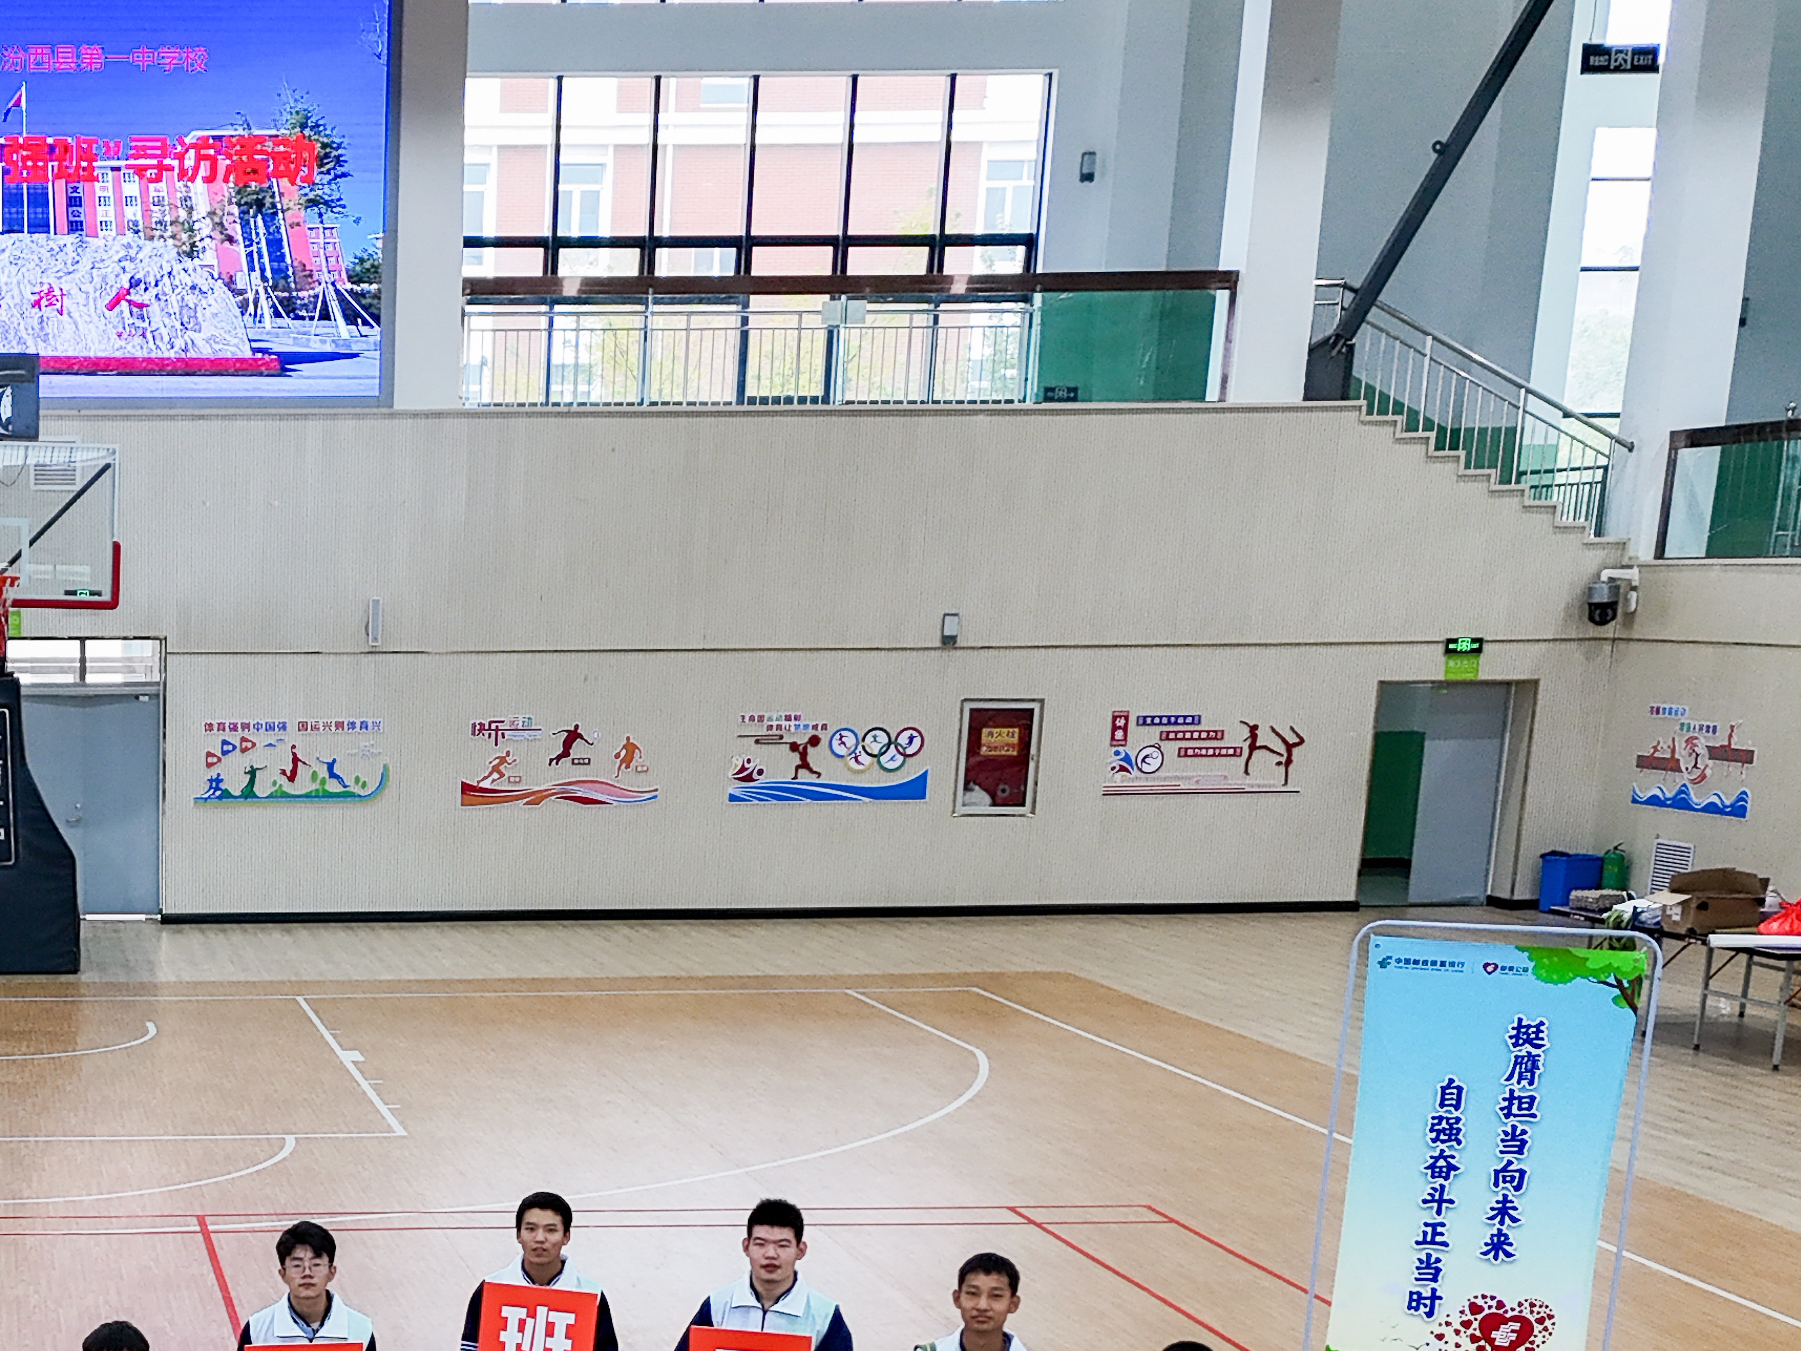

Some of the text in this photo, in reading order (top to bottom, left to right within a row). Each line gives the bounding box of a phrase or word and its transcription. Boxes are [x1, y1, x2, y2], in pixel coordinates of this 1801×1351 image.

[0, 44, 209, 73] 汾西县第一中学校
[1633, 54, 1654, 65] EXIT
[1406, 1077, 1465, 1318] 自强奋斗正当时
[1480, 1017, 1548, 1262] 挺膺担当向未来
